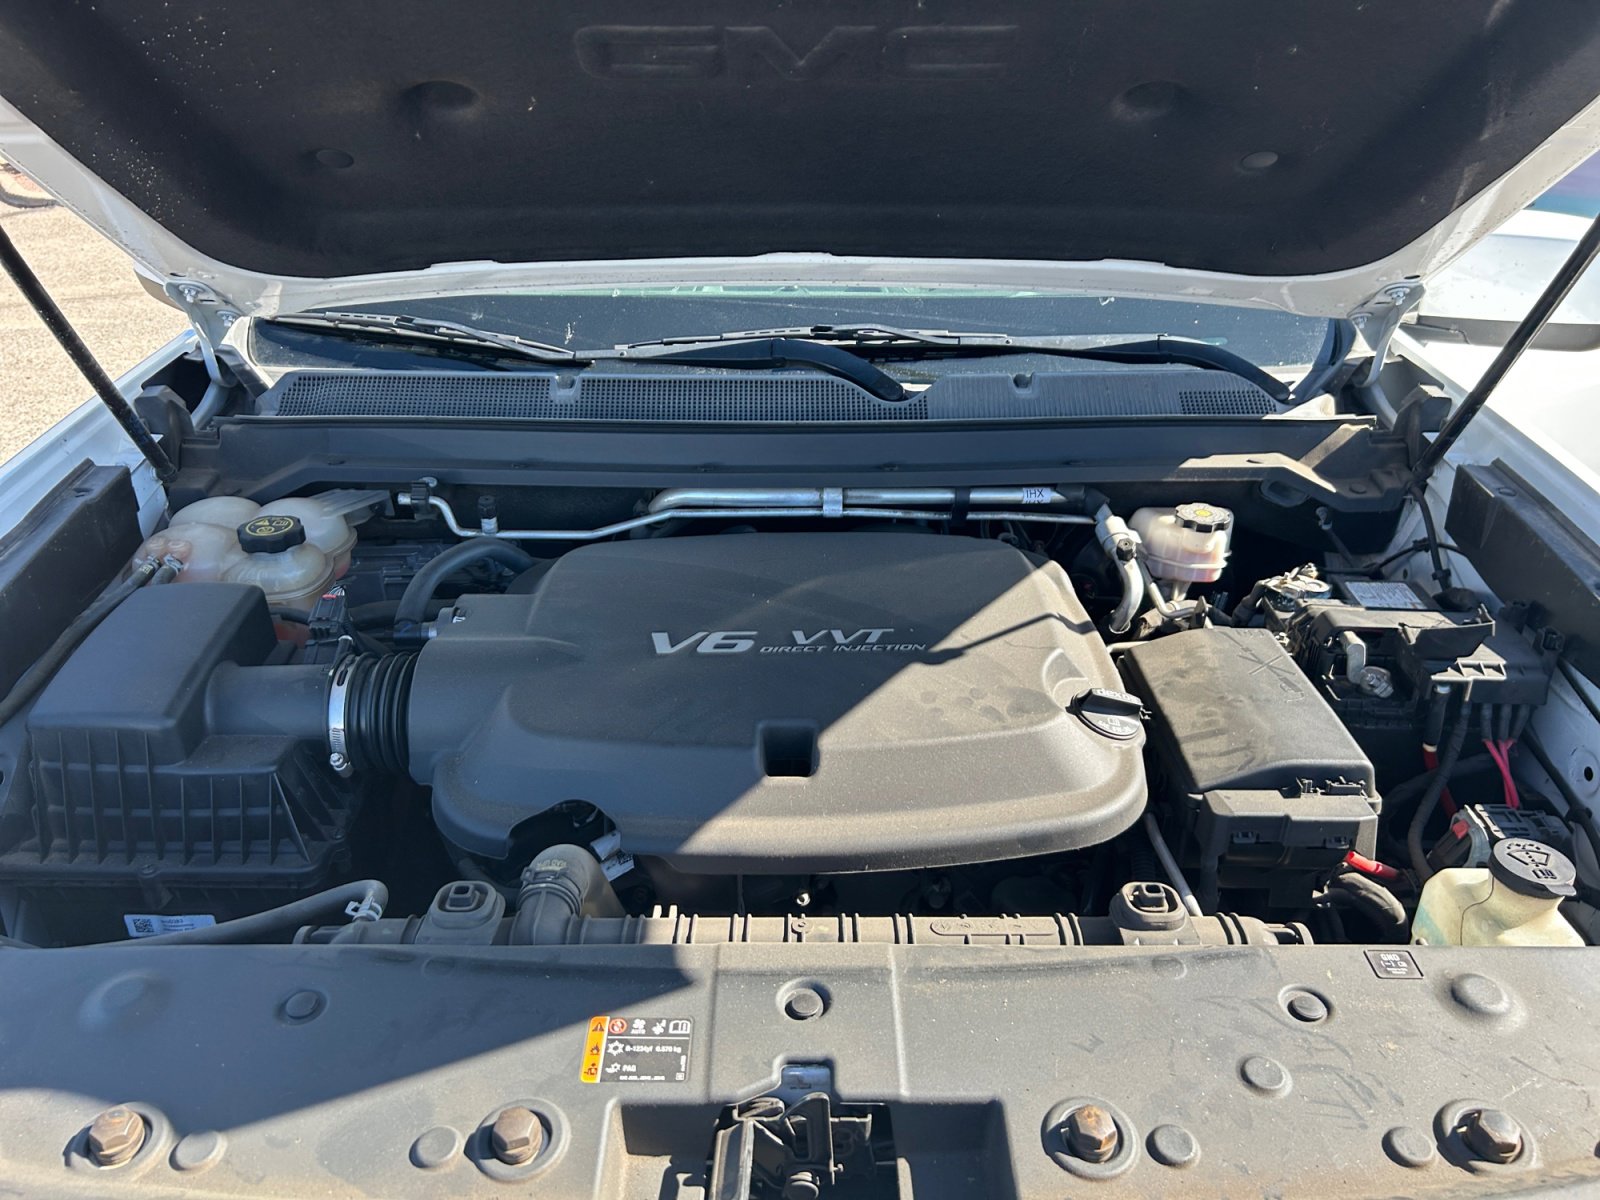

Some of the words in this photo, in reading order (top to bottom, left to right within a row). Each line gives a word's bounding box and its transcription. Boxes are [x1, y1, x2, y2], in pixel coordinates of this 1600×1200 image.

[573, 24, 1020, 80] GMC
[651, 631, 758, 654] V6
[791, 628, 895, 645] VVT
[759, 643, 828, 653] DIRECT
[832, 642, 927, 652] INJECTION
